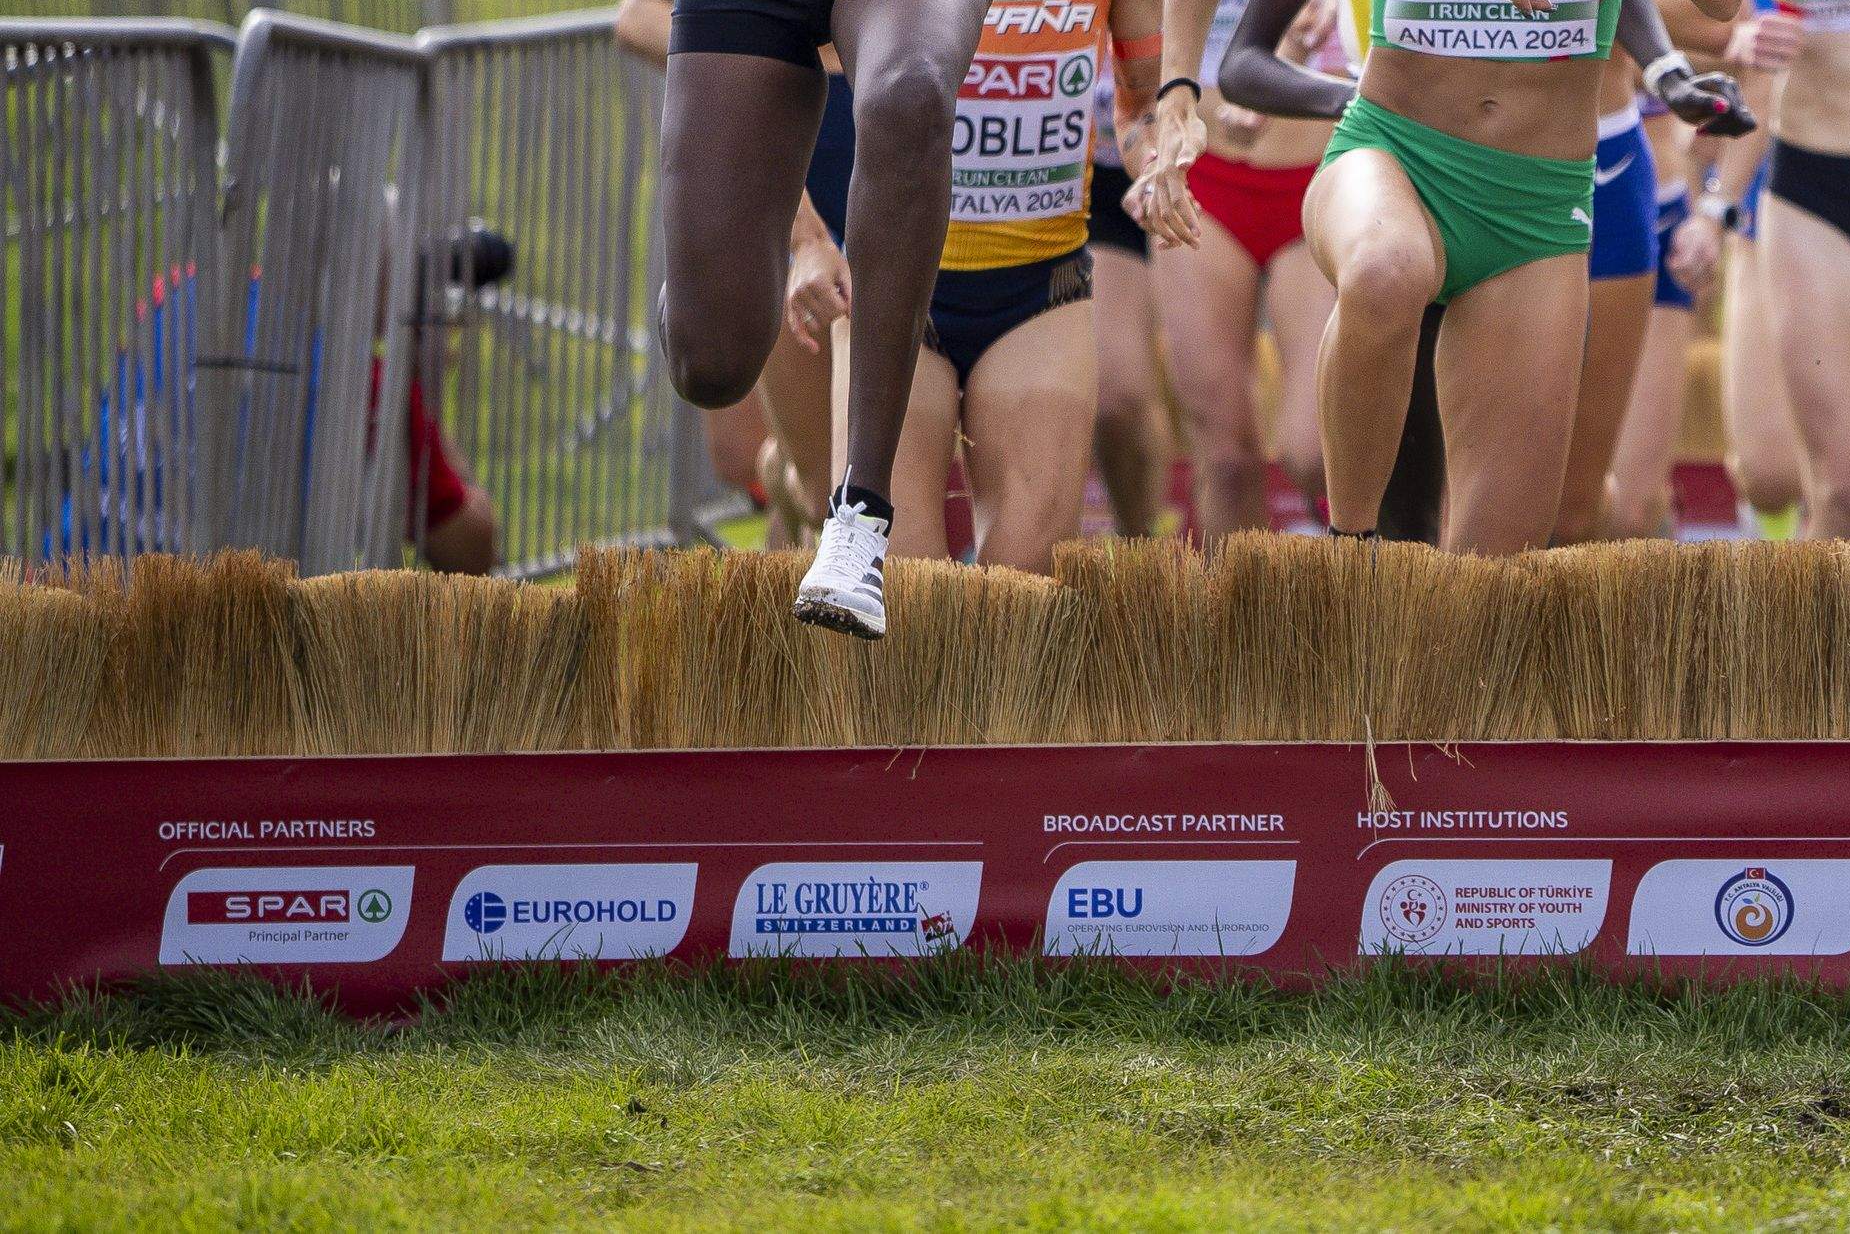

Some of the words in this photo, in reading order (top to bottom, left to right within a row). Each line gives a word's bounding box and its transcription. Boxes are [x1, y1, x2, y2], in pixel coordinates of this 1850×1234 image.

[1439, 4, 1482, 19] RUN
[1399, 27, 1519, 50] ANTALYA
[1525, 27, 1584, 50] 2024
[951, 109, 1084, 157] OBLES
[1026, 188, 1075, 212] 2024
[1043, 815, 1177, 832] BROADCAST
[1182, 814, 1285, 832] PARTNER
[1358, 812, 1415, 829] HOST
[1420, 811, 1568, 828] INSTITUTIONS
[159, 822, 254, 840] OFFICIAL
[260, 820, 376, 838] PARTNERS
[756, 883, 788, 915] LE
[1455, 887, 1516, 898] REPUBLIC
[1518, 887, 1536, 898] OF
[1538, 884, 1593, 898] TÜRKİYE
[225, 896, 347, 918] SPAR
[513, 899, 677, 924] EUROHOLD
[1068, 887, 1143, 918] EBU
[1455, 902, 1517, 914] MINISTRY
[1519, 902, 1535, 914] OF
[1538, 902, 1582, 914] YOUTH
[763, 918, 910, 932] SWITZERLAND
[1067, 924, 1123, 933] OPERATING
[1126, 923, 1185, 933] EUROVISION
[1188, 924, 1208, 933] AND
[1212, 923, 1270, 933] EURORADIO
[1455, 918, 1484, 929] AND
[1486, 918, 1535, 929] SPORTS
[249, 930, 301, 944] Principal
[304, 930, 350, 942] Partner
